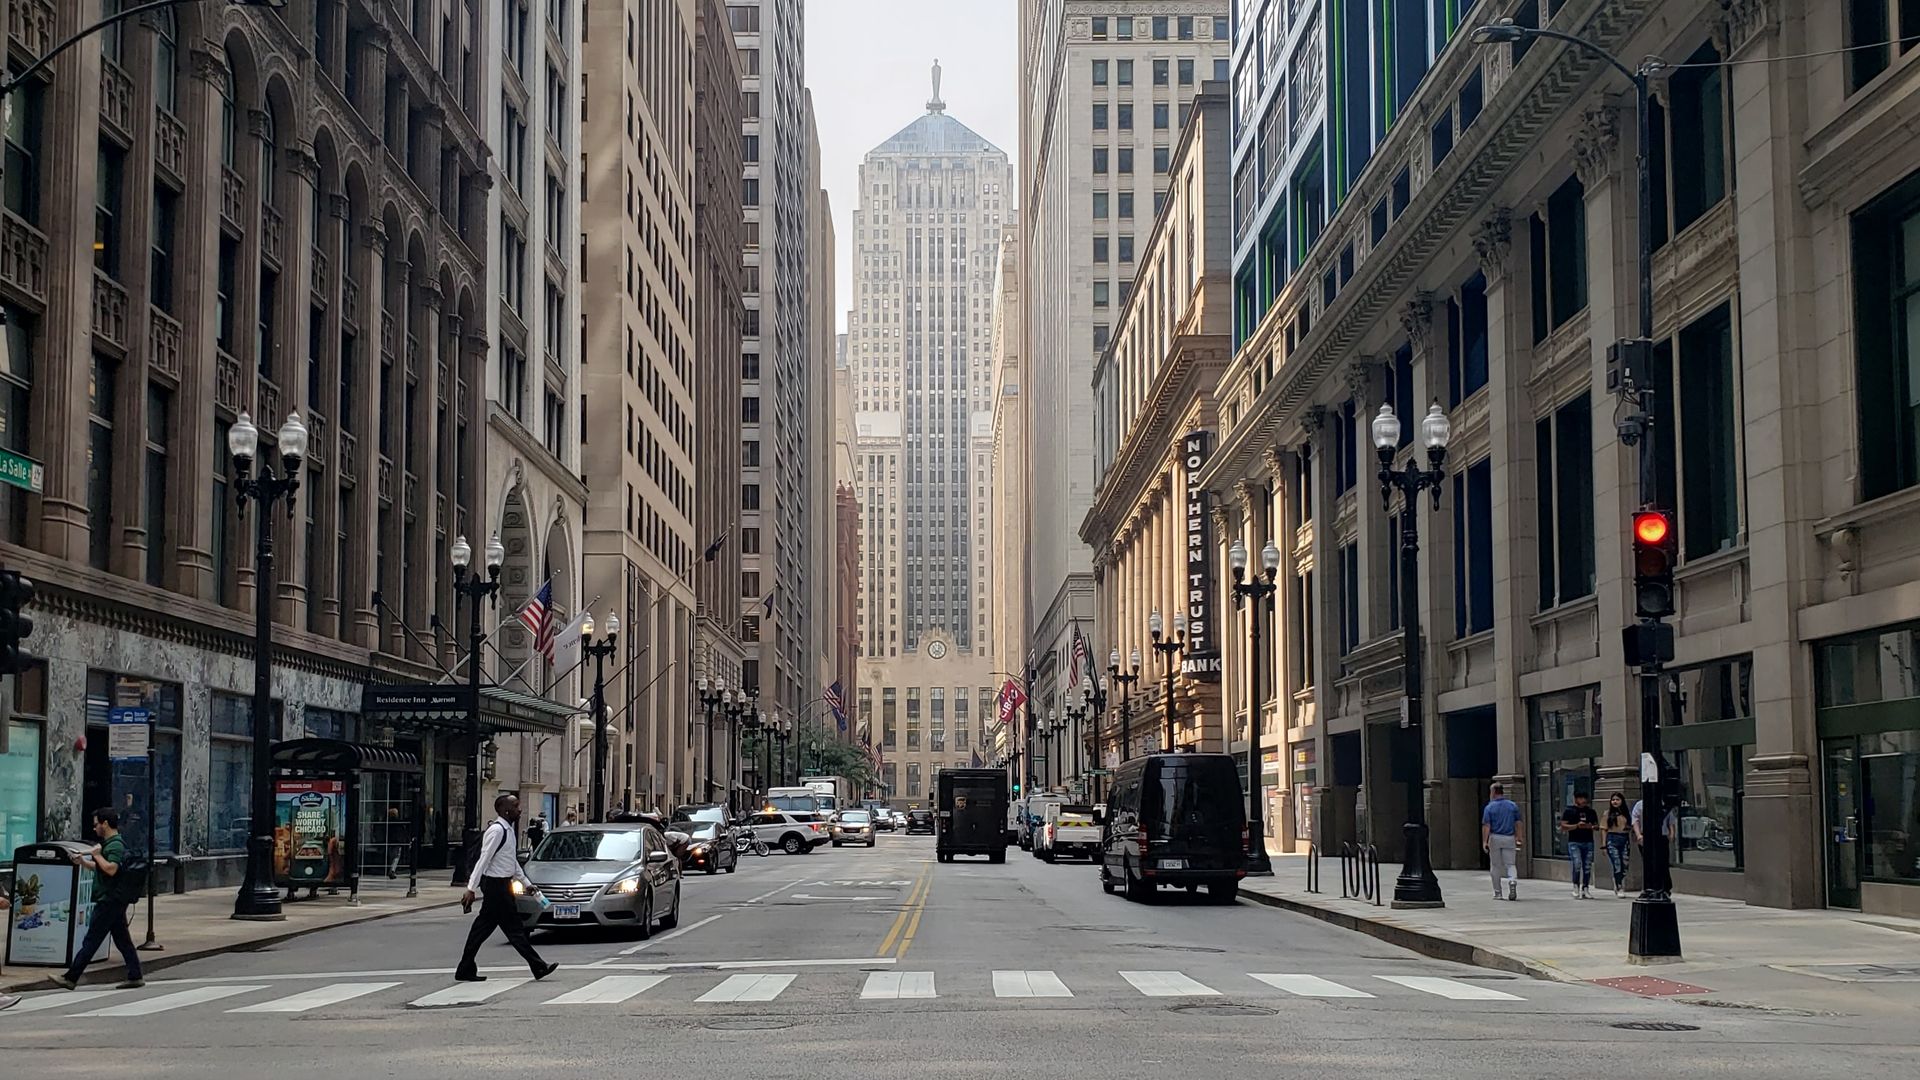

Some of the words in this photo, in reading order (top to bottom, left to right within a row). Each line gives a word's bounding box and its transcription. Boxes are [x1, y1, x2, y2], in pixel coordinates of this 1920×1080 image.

[8, 458, 27, 480] Salle
[1187, 440, 1202, 562] NORTHERN
[1189, 573, 1204, 650] TRUST
[1181, 658, 1221, 673] BANK
[376, 696, 412, 704] Residence
[413, 696, 426, 704] Inn
[297, 811, 325, 819] SHARE-
[295, 818, 326, 826] WORTHY
[295, 825, 326, 833] CHICAGO
